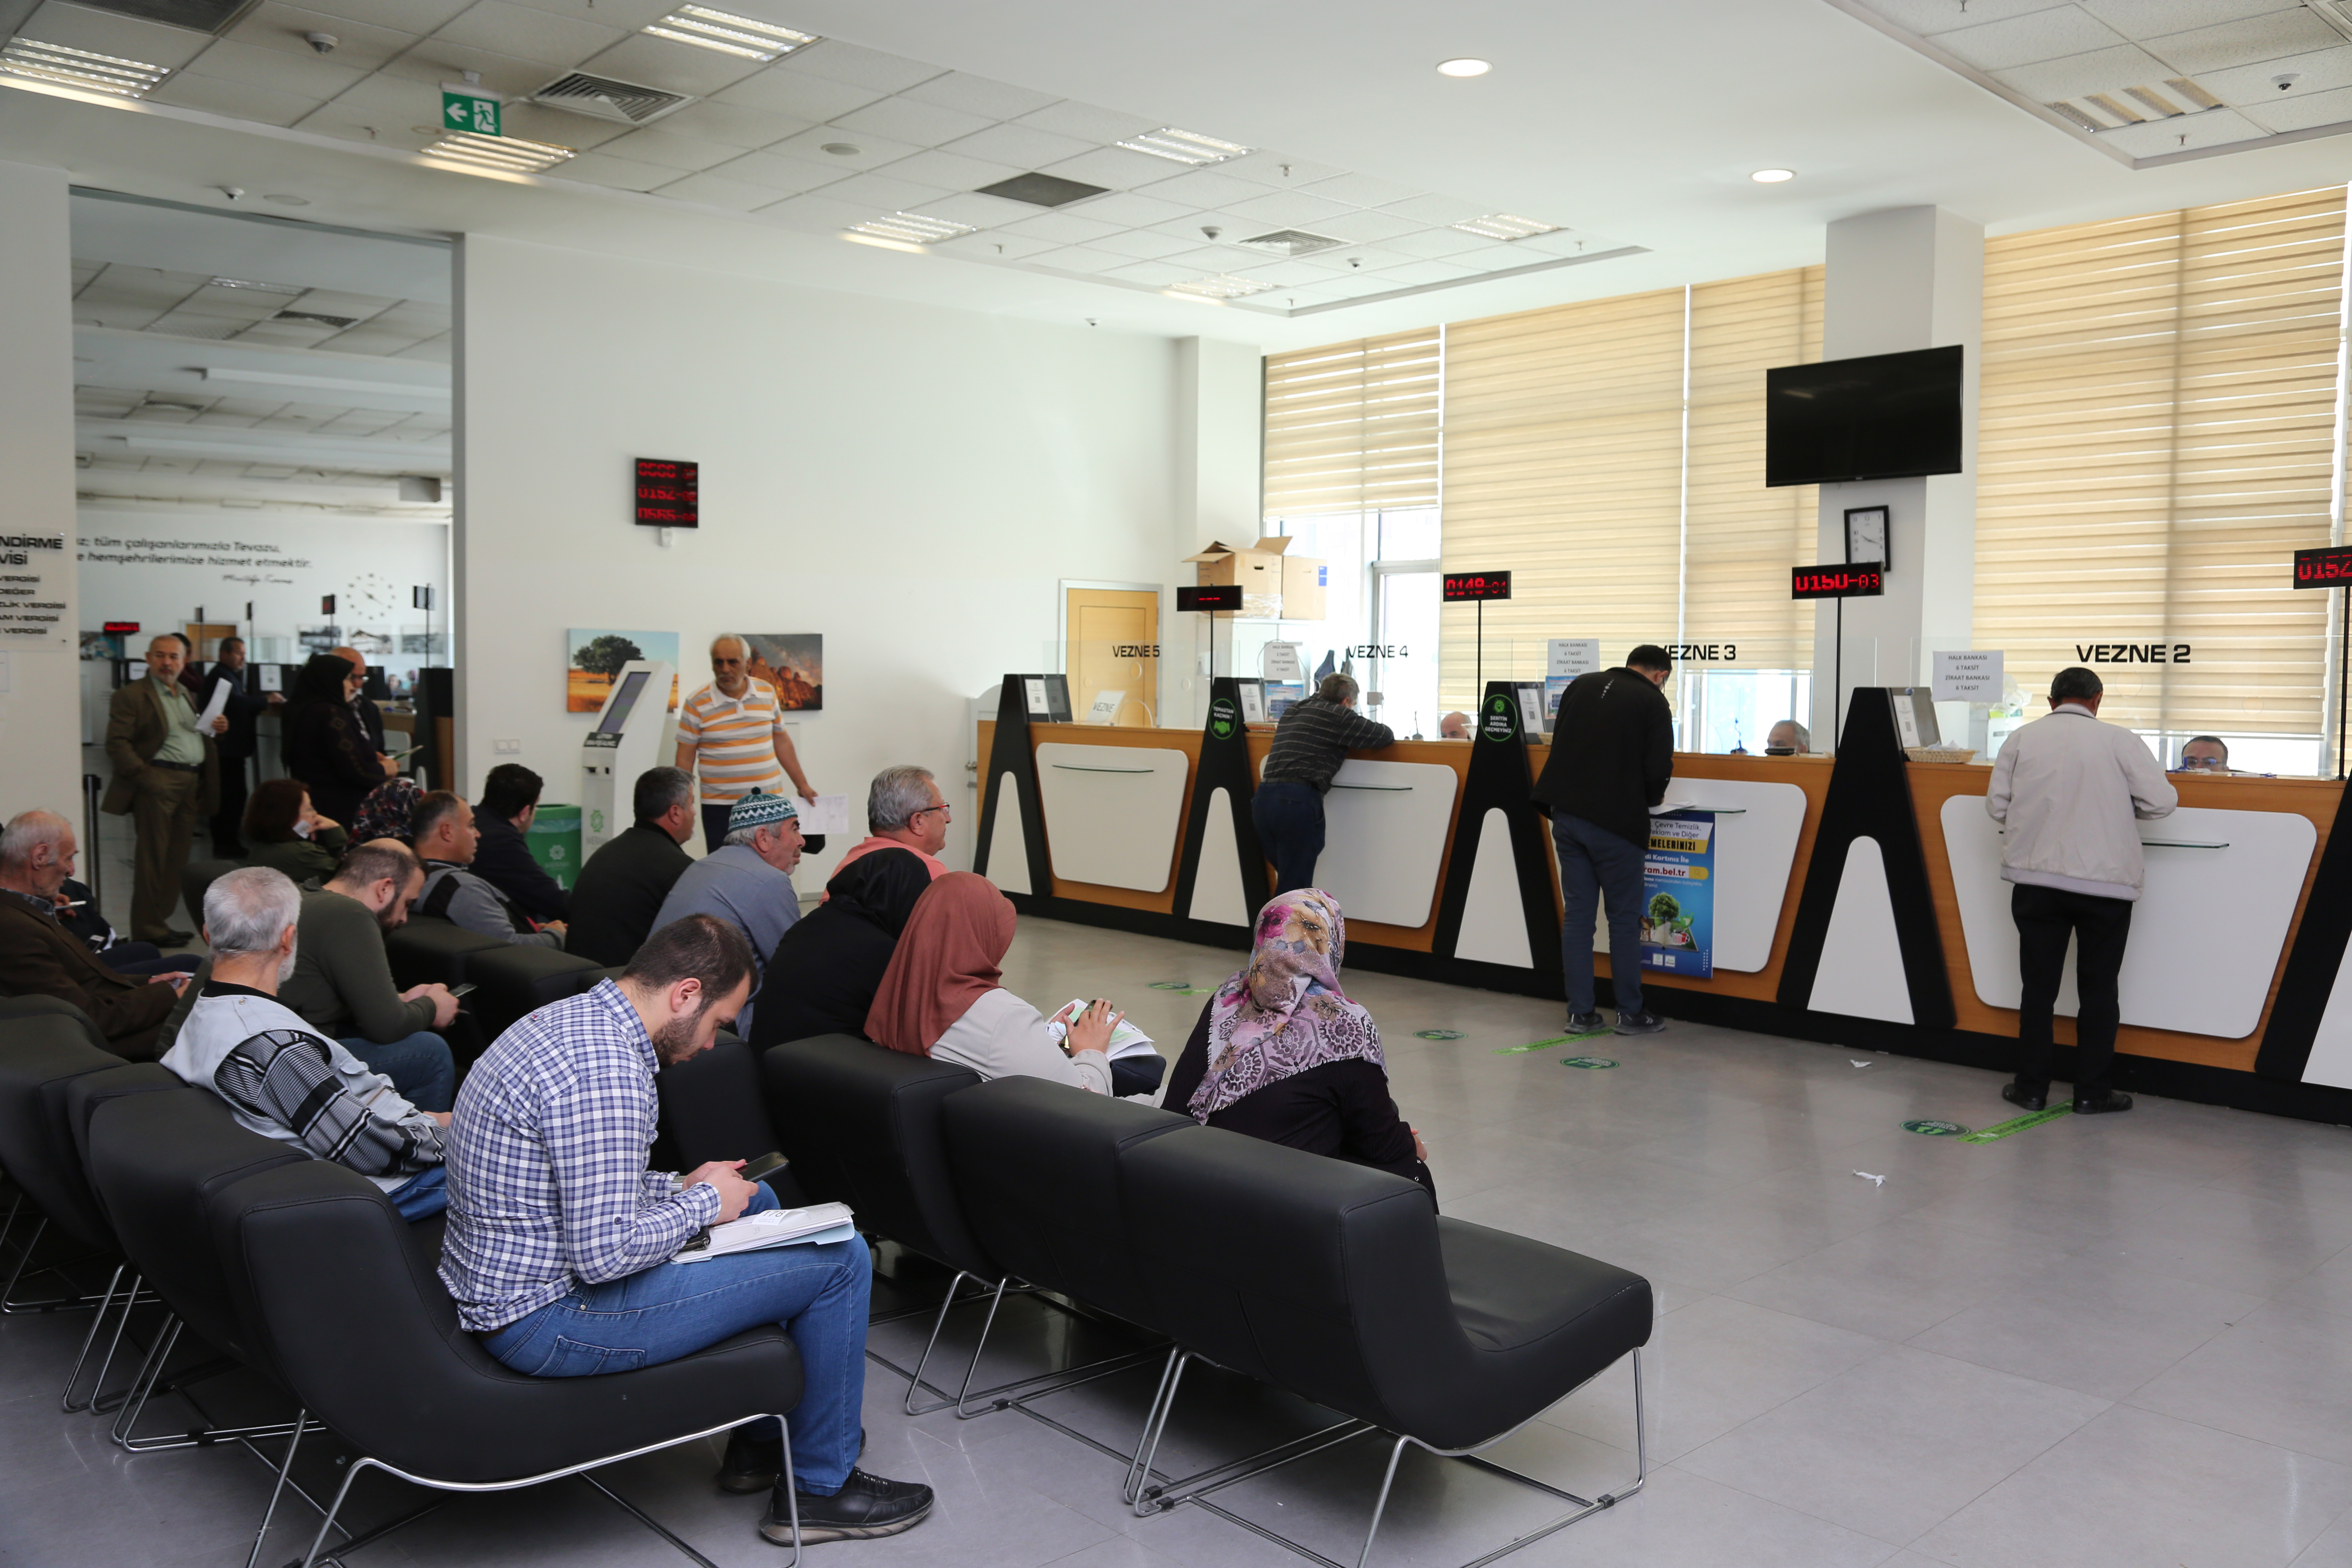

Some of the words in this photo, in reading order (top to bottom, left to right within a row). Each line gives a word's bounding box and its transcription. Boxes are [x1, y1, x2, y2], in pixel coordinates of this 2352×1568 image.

[1113, 645, 1150, 657] VEZNE
[1153, 645, 1160, 657] 5
[1348, 645, 1395, 658] VEZNE
[1400, 645, 1408, 658] 4
[1664, 645, 1719, 660] EZNE
[1724, 645, 1736, 660] 3
[2076, 644, 2167, 663] VEZNE
[2173, 644, 2191, 663] 2
[1093, 702, 1115, 713] VEZNE
[1682, 831, 1699, 840] Diğer
[1653, 854, 1679, 862] Kartınız
[1681, 855, 1689, 863] İle
